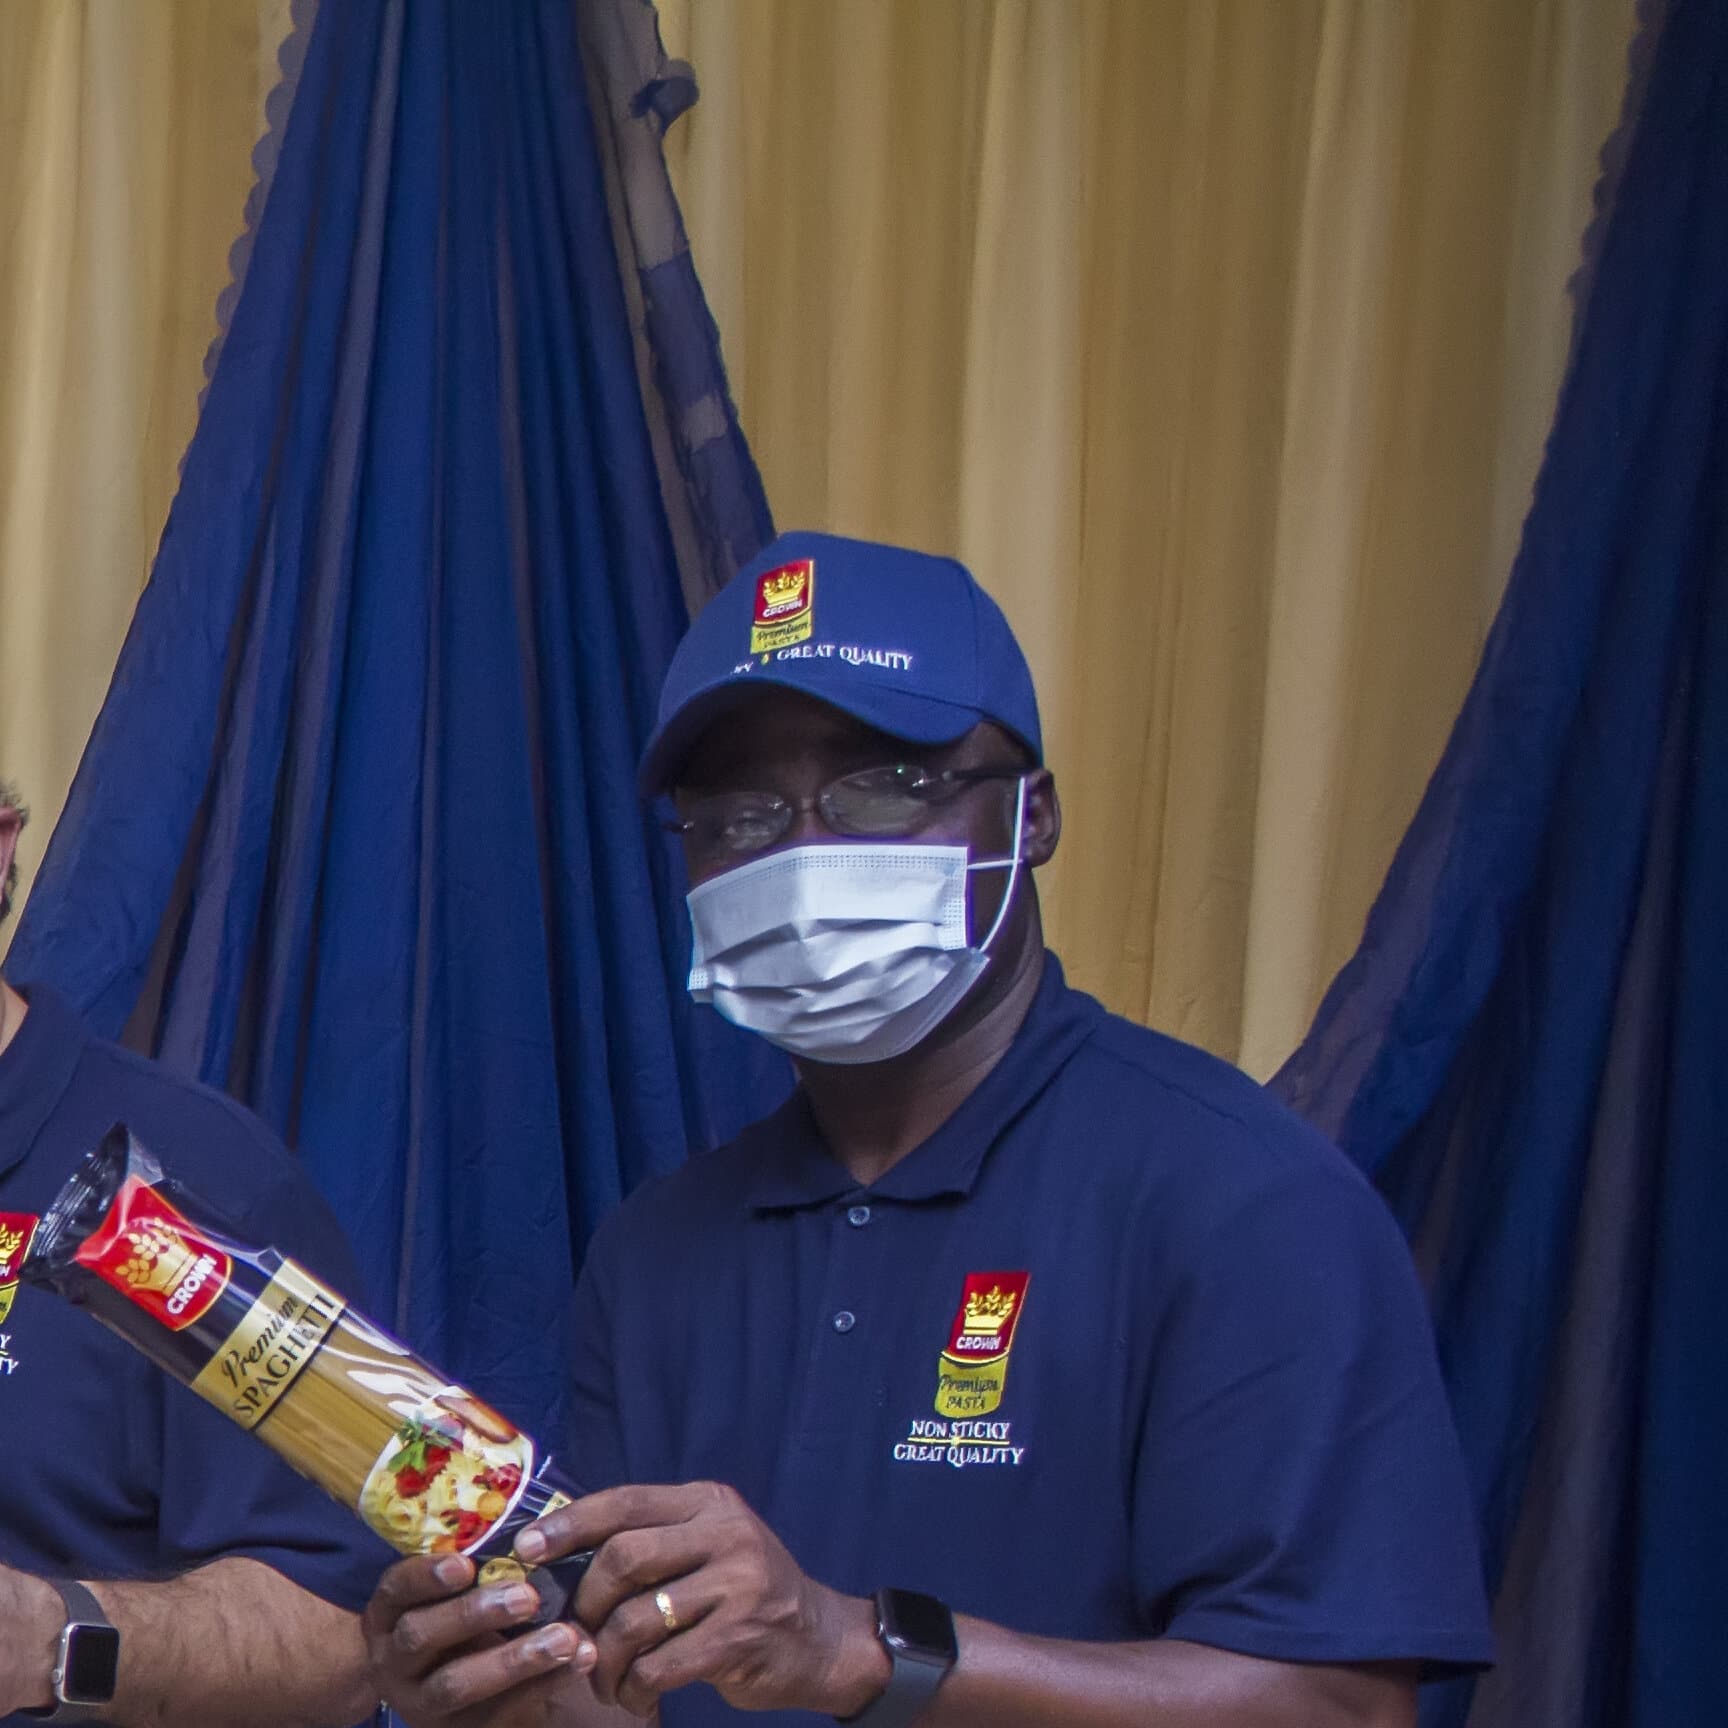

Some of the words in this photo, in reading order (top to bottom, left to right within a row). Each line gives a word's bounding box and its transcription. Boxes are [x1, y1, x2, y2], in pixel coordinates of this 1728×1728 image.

[762, 598, 803, 618] CROWN
[776, 644, 836, 661] GREAT
[838, 646, 913, 670] QUALITY
[166, 1253, 218, 1315] CROWN
[221, 1294, 299, 1389] Premium
[955, 1335, 1001, 1351] CROWN
[233, 1292, 337, 1419] SPAGHETTI
[944, 1394, 986, 1410] PASTA
[909, 1419, 948, 1438] NON
[947, 1421, 1011, 1440] STICKY
[893, 1443, 946, 1462] GREAT
[946, 1446, 1024, 1469] QUALITY
